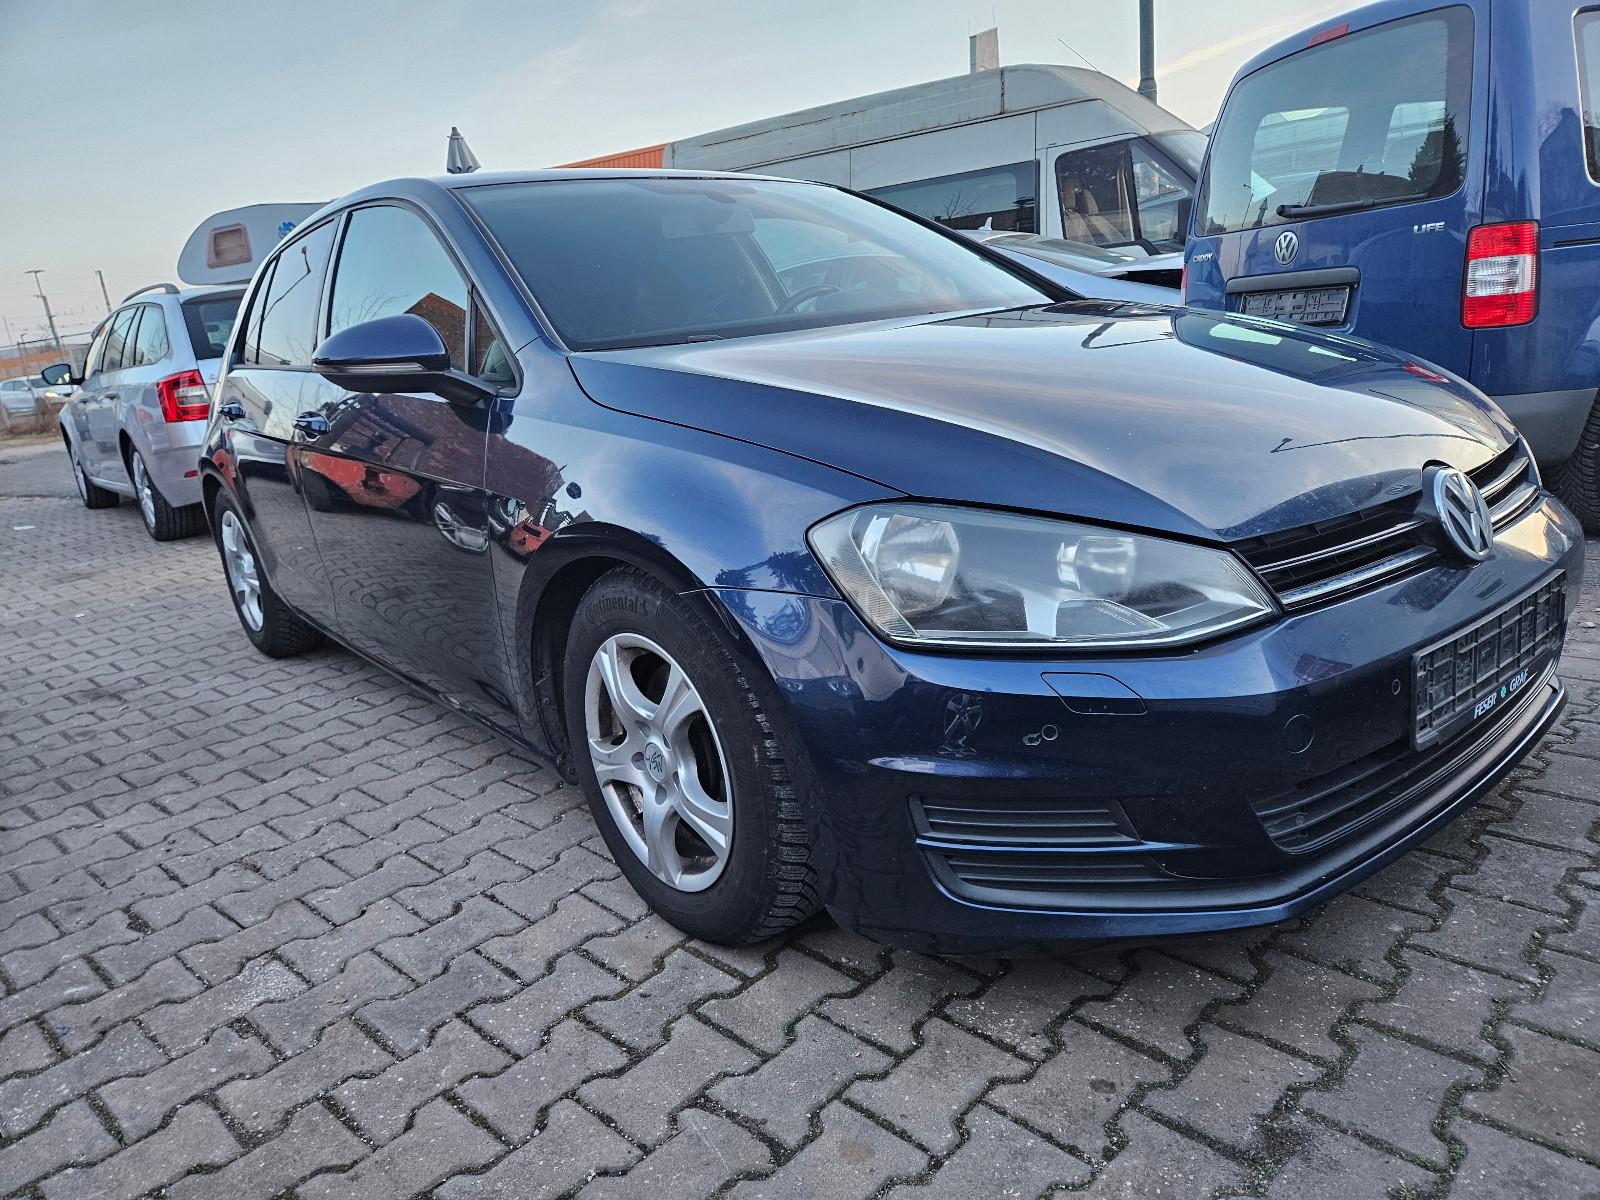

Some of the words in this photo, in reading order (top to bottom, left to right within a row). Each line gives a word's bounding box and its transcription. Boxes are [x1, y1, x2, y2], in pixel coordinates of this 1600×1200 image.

[1413, 221, 1446, 234] LIFE
[1275, 231, 1299, 266] VW
[1434, 469, 1494, 561] VW
[585, 594, 639, 624] Continental
[1473, 692, 1498, 720] FESER
[1509, 667, 1529, 692] GRAF
